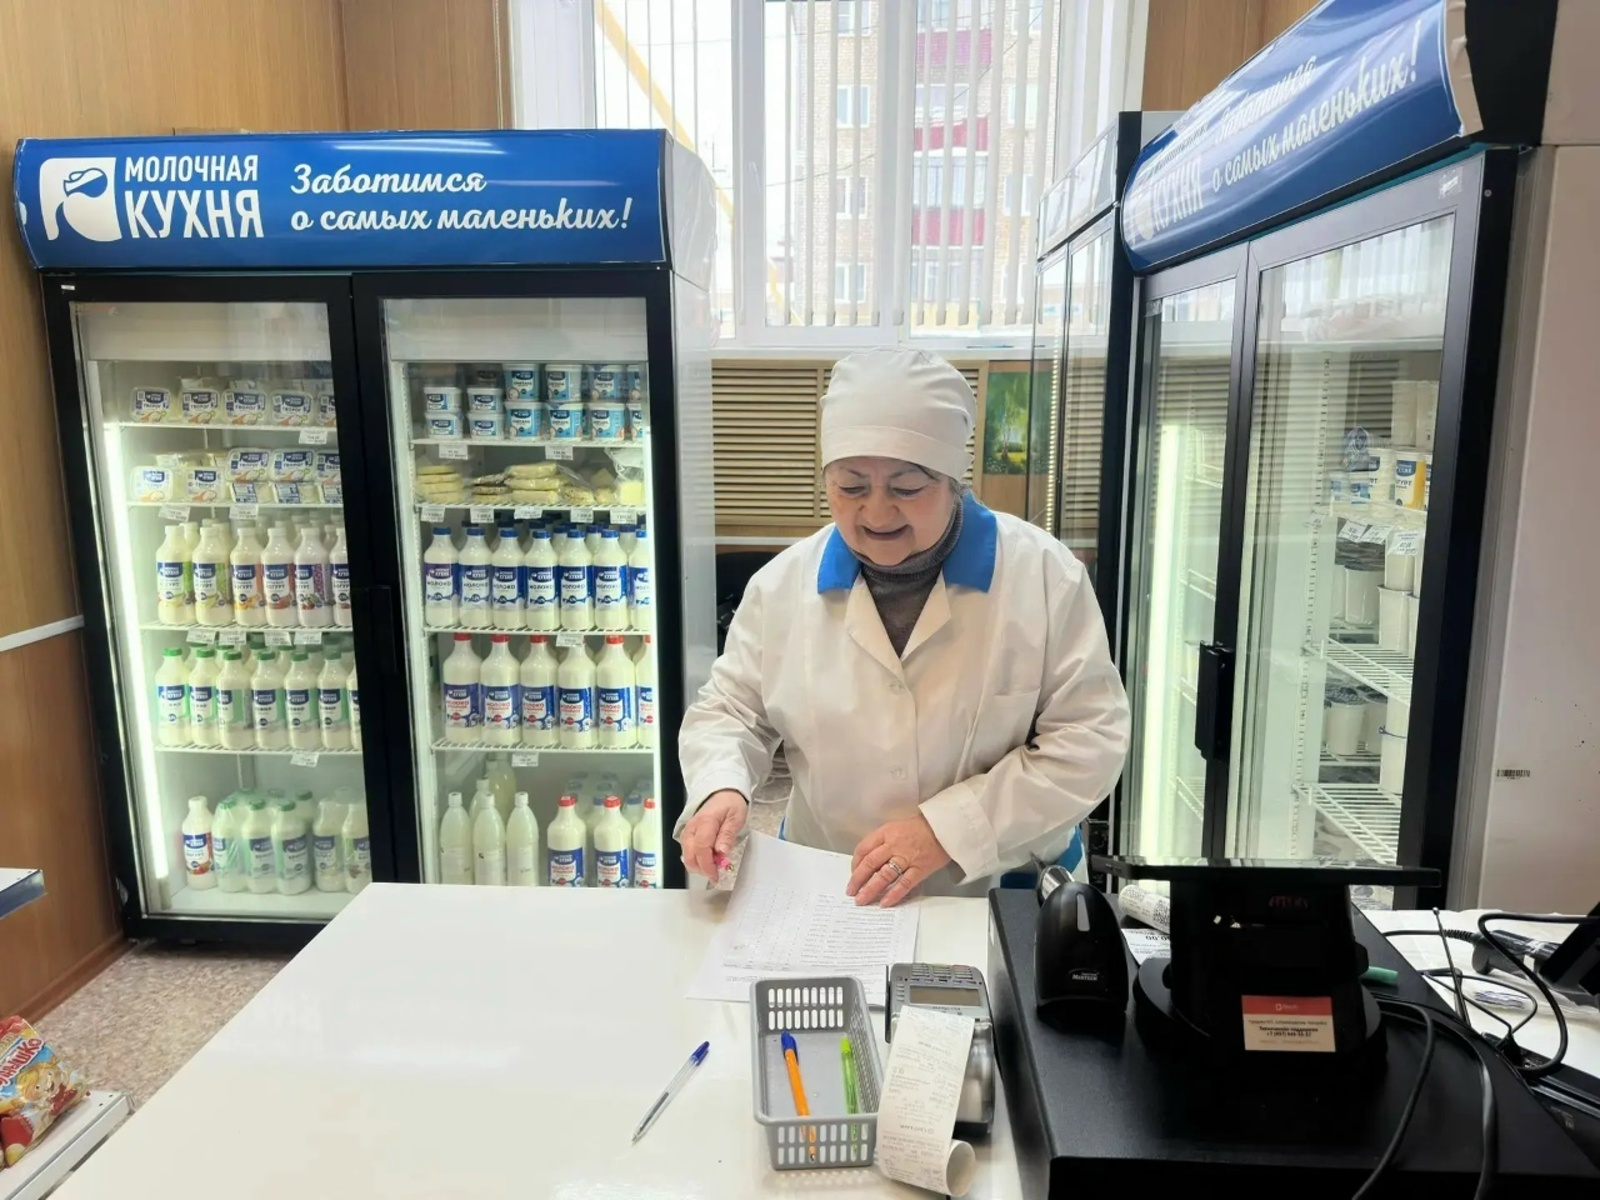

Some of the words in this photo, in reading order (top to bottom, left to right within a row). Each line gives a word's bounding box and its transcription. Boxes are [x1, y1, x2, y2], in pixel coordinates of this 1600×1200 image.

[1225, 138, 1280, 185] самых
[1281, 19, 1422, 156] маленьких!
[124, 155, 259, 182] МОЛОЧНАЯ
[290, 163, 487, 194] Заботимся
[124, 189, 264, 239] КУХНЯ
[290, 209, 313, 231] о
[320, 207, 431, 231] самых
[437, 197, 633, 230] маленьких!
